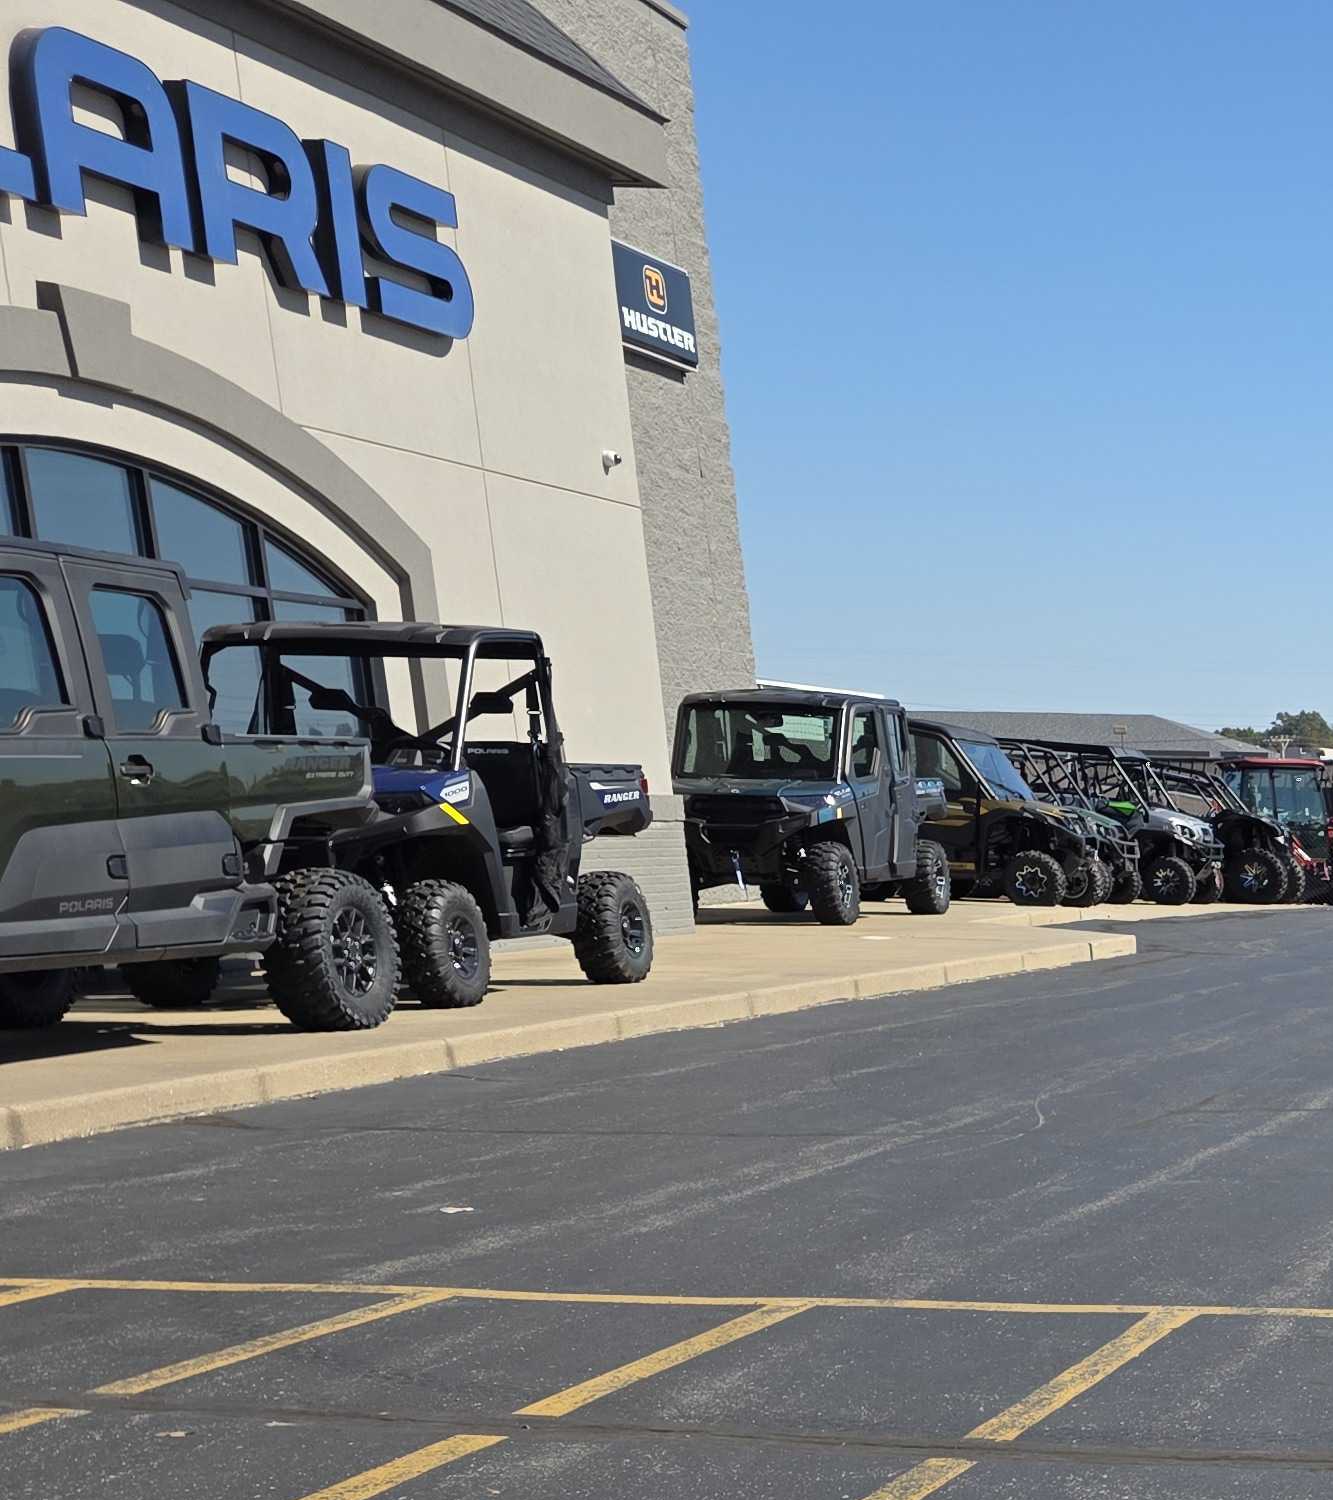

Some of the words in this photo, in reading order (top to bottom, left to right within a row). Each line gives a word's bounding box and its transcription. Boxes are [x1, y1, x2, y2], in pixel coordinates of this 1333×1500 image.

[0, 25, 475, 341] ARIS
[621, 306, 696, 353] HUSTLER
[444, 785, 468, 797] 1000
[603, 790, 641, 804] RANGER
[58, 897, 115, 913] POLARIS
